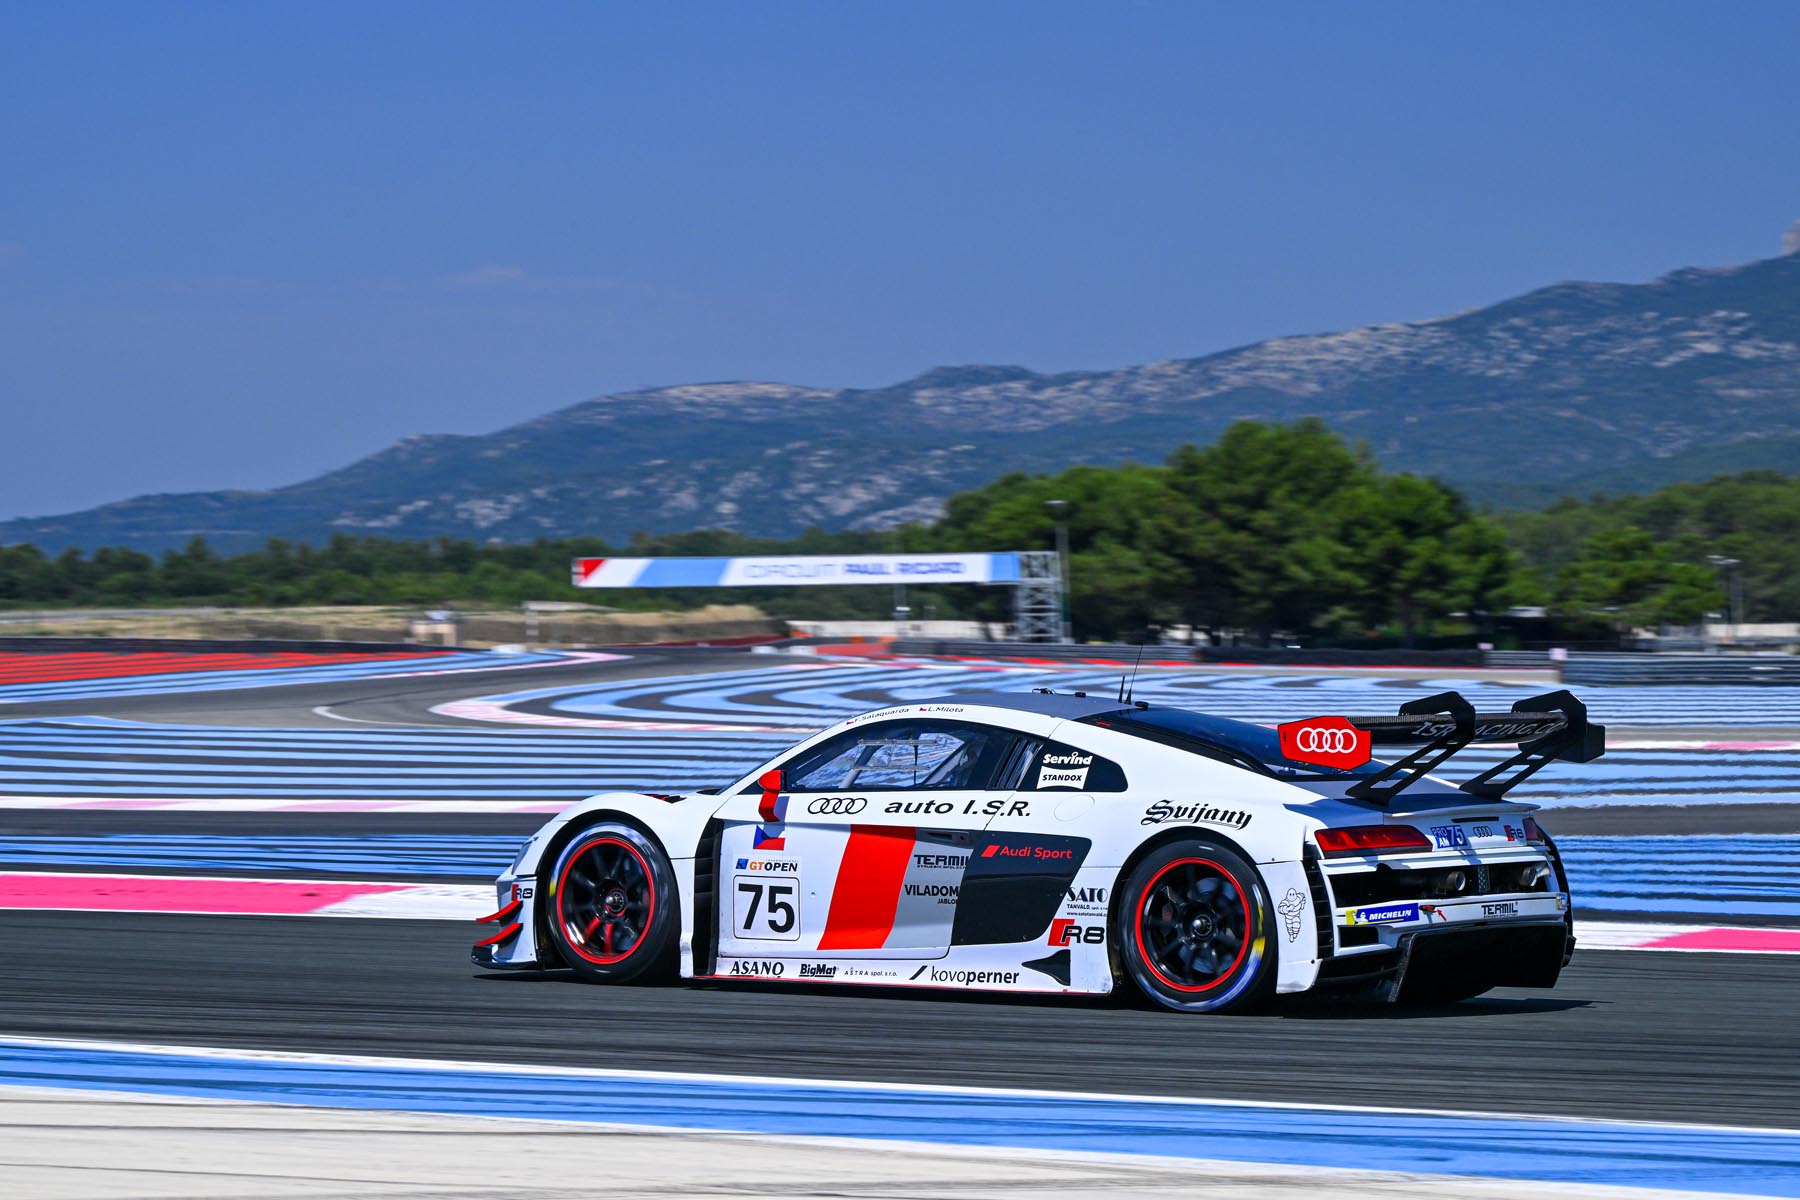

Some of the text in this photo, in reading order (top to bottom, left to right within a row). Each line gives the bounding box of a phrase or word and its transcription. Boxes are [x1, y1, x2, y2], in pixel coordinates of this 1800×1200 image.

[1043, 751, 1093, 765] Servind
[1042, 774, 1083, 782] STANDOX
[884, 799, 1032, 817] auto I.S.R.
[1140, 799, 1253, 831] Svijany
[1447, 825, 1465, 846] 75
[1000, 846, 1073, 860] Audi Sport
[1066, 886, 1109, 903] SATO
[738, 883, 795, 934] 75
[1369, 909, 1412, 921] MICHELIN
[1481, 902, 1518, 916] TERMIL
[1060, 925, 1106, 945] R8
[800, 963, 837, 977] BigMat
[930, 965, 1020, 986] kovoperner
